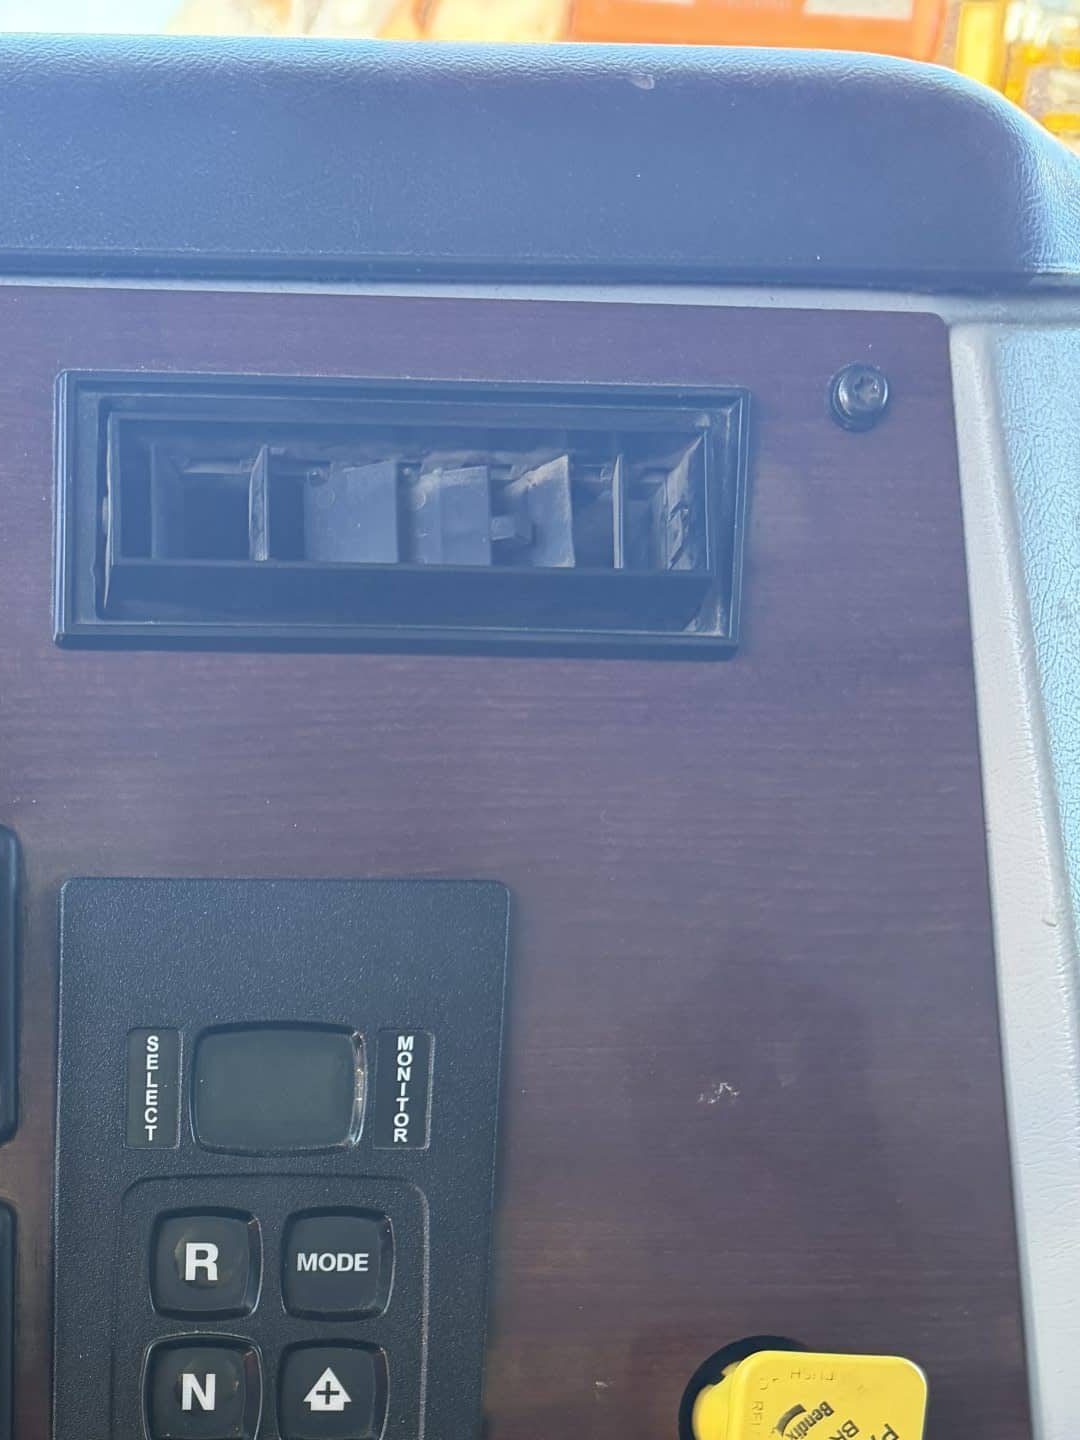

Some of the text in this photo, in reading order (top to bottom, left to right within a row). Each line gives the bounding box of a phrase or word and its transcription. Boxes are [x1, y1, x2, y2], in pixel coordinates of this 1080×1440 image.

[144, 1035, 159, 1141] SELECT
[393, 1035, 414, 1143] MONITOR
[185, 1243, 219, 1281] R
[297, 1253, 369, 1272] MODE
[182, 1374, 216, 1411] N
